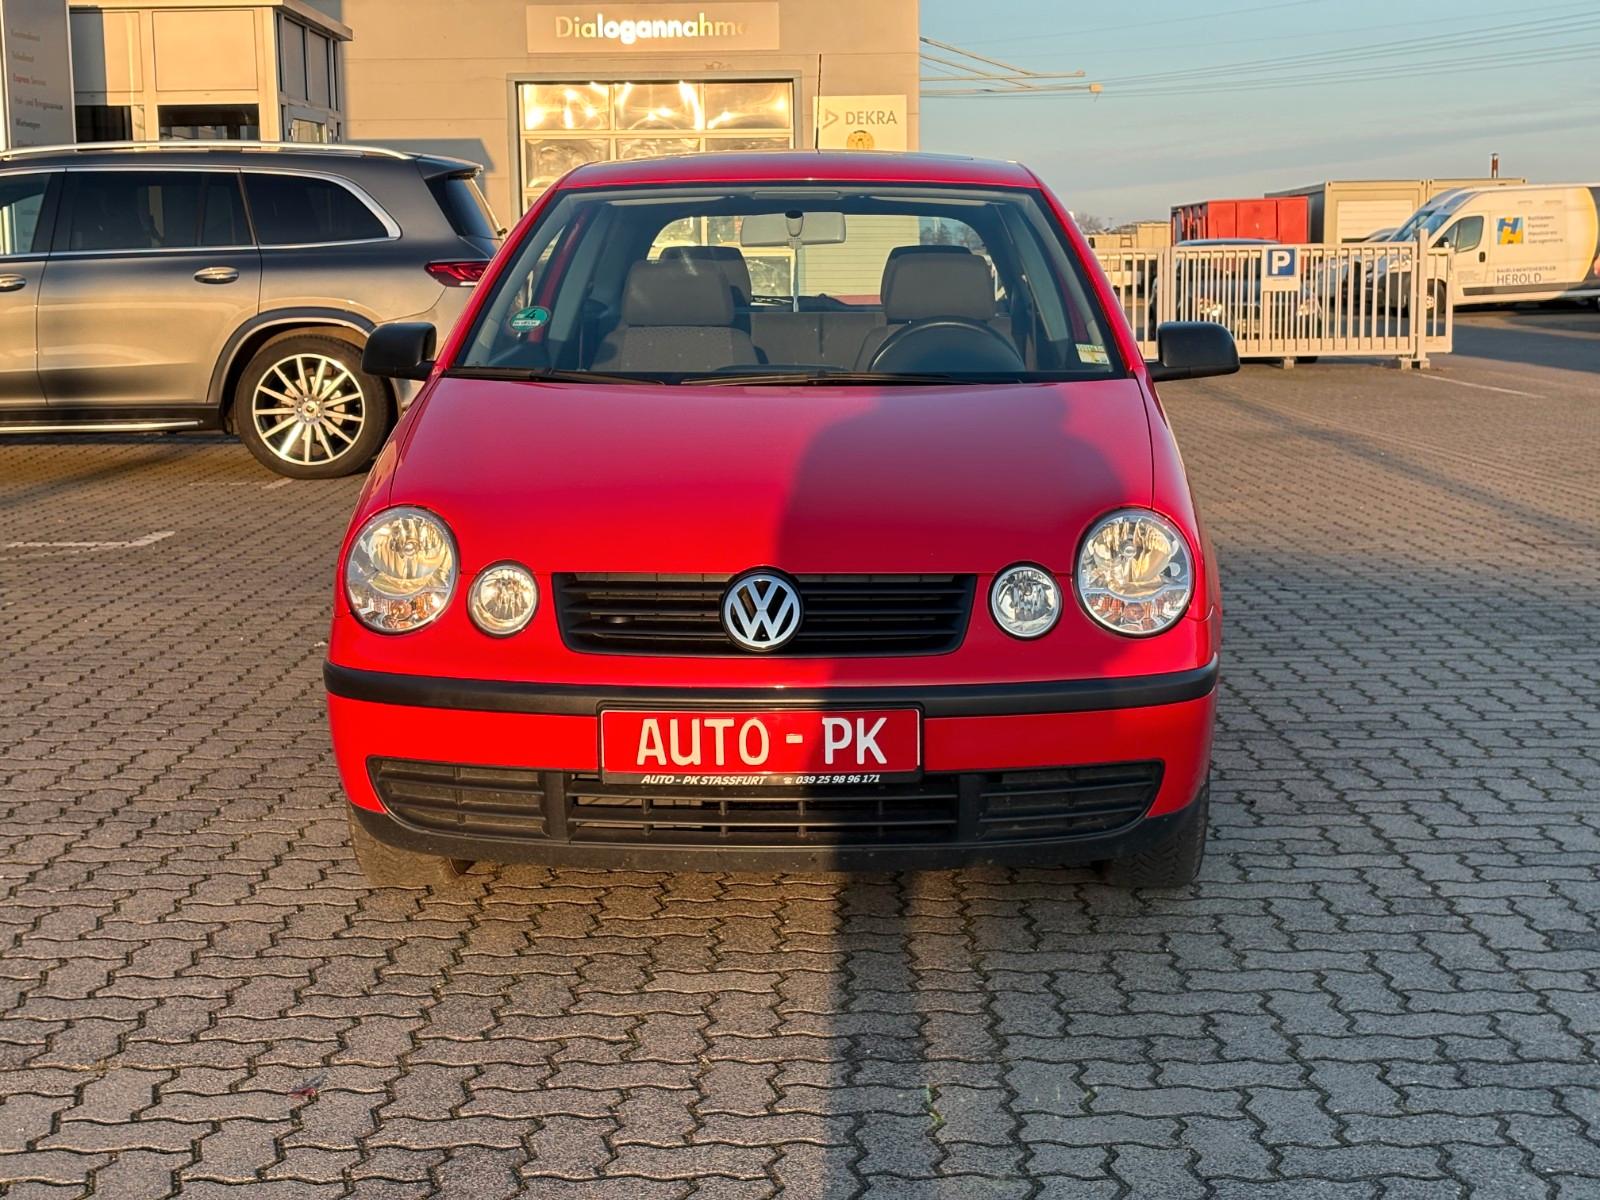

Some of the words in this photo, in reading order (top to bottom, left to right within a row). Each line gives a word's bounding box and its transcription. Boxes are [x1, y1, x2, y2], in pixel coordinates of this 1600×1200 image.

[845, 110, 898, 125] DEKRA
[1271, 250, 1291, 275] P
[1496, 272, 1542, 285] HEROLD
[636, 717, 770, 766] AUTO
[785, 733, 804, 743] -
[822, 716, 888, 765] PK
[641, 775, 675, 785] AUTO
[682, 775, 699, 785] PK
[700, 775, 766, 785] STASSFURT
[796, 775, 815, 784] 039
[816, 775, 832, 784] 25
[832, 775, 847, 784] 98
[847, 775, 862, 784] 96
[862, 774, 880, 783] 171
